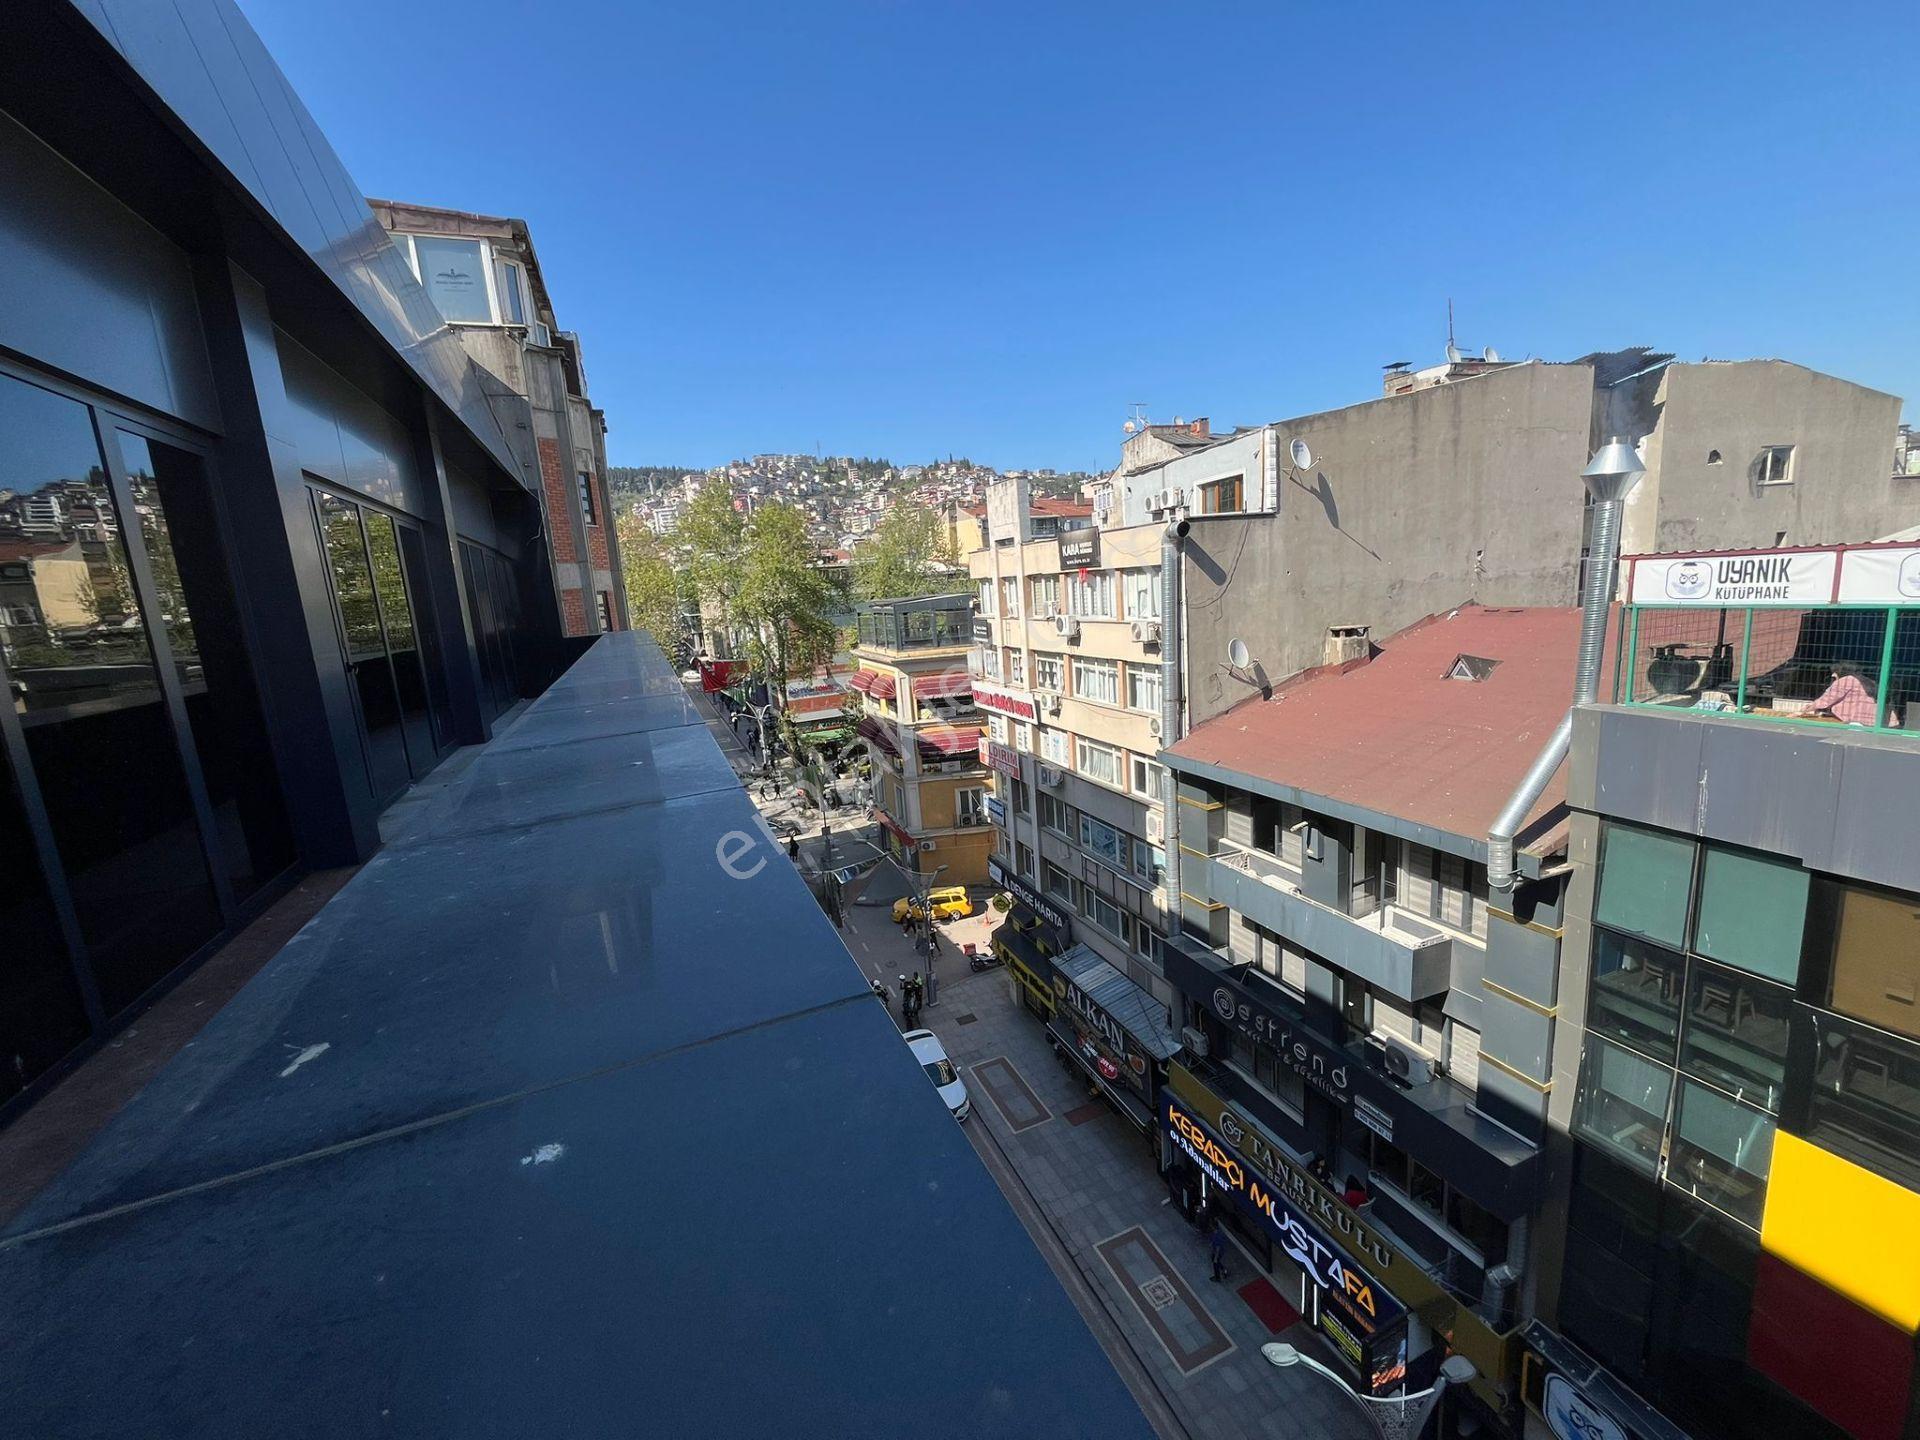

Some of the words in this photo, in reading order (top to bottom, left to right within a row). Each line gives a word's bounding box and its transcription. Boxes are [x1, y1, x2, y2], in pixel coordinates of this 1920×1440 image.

[1717, 558, 1792, 584] UYANIK
[1010, 881, 1034, 907] DENGE
[1066, 984, 1125, 1054] ALKAN
[1250, 1137, 1392, 1269] TANRIKULU
[1266, 1169, 1313, 1214] BEAUTY
[1250, 1183, 1376, 1317] MUSTAFA
